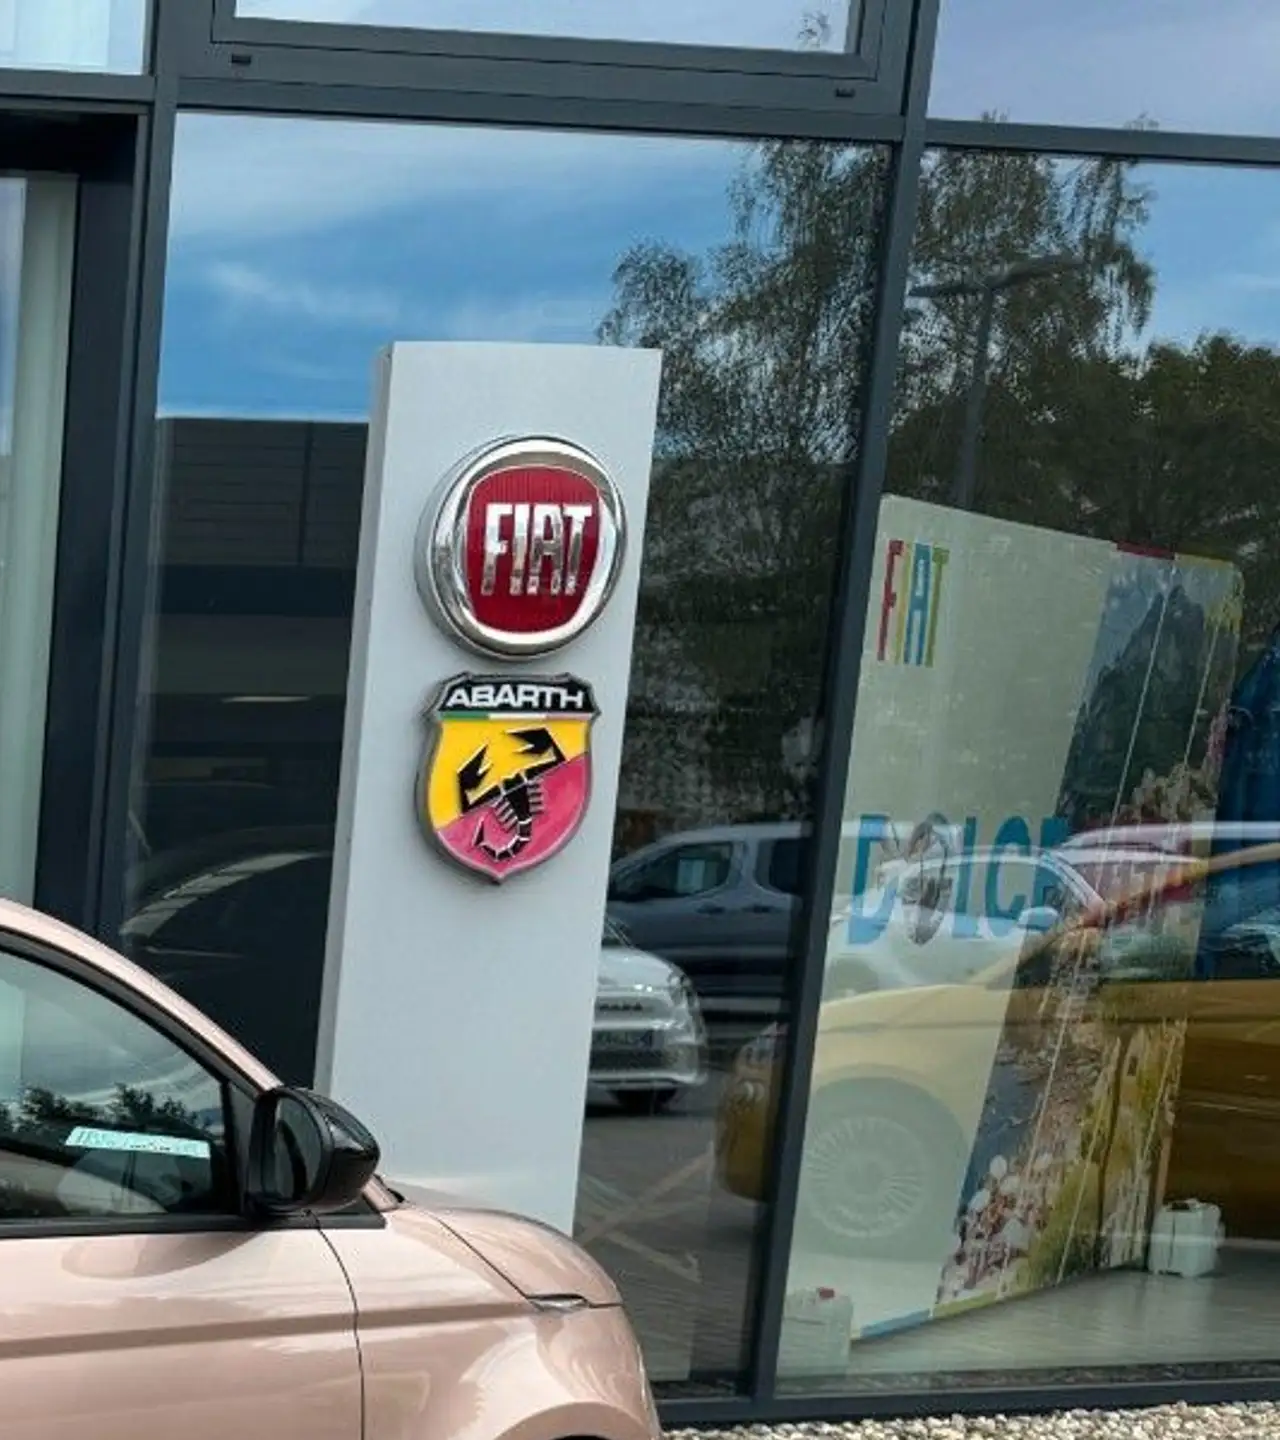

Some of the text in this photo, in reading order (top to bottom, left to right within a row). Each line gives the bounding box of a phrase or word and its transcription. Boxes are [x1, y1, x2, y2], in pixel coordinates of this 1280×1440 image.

[481, 503, 593, 595] FIAT
[877, 539, 950, 668] FIAT
[445, 684, 584, 709] ABARTH
